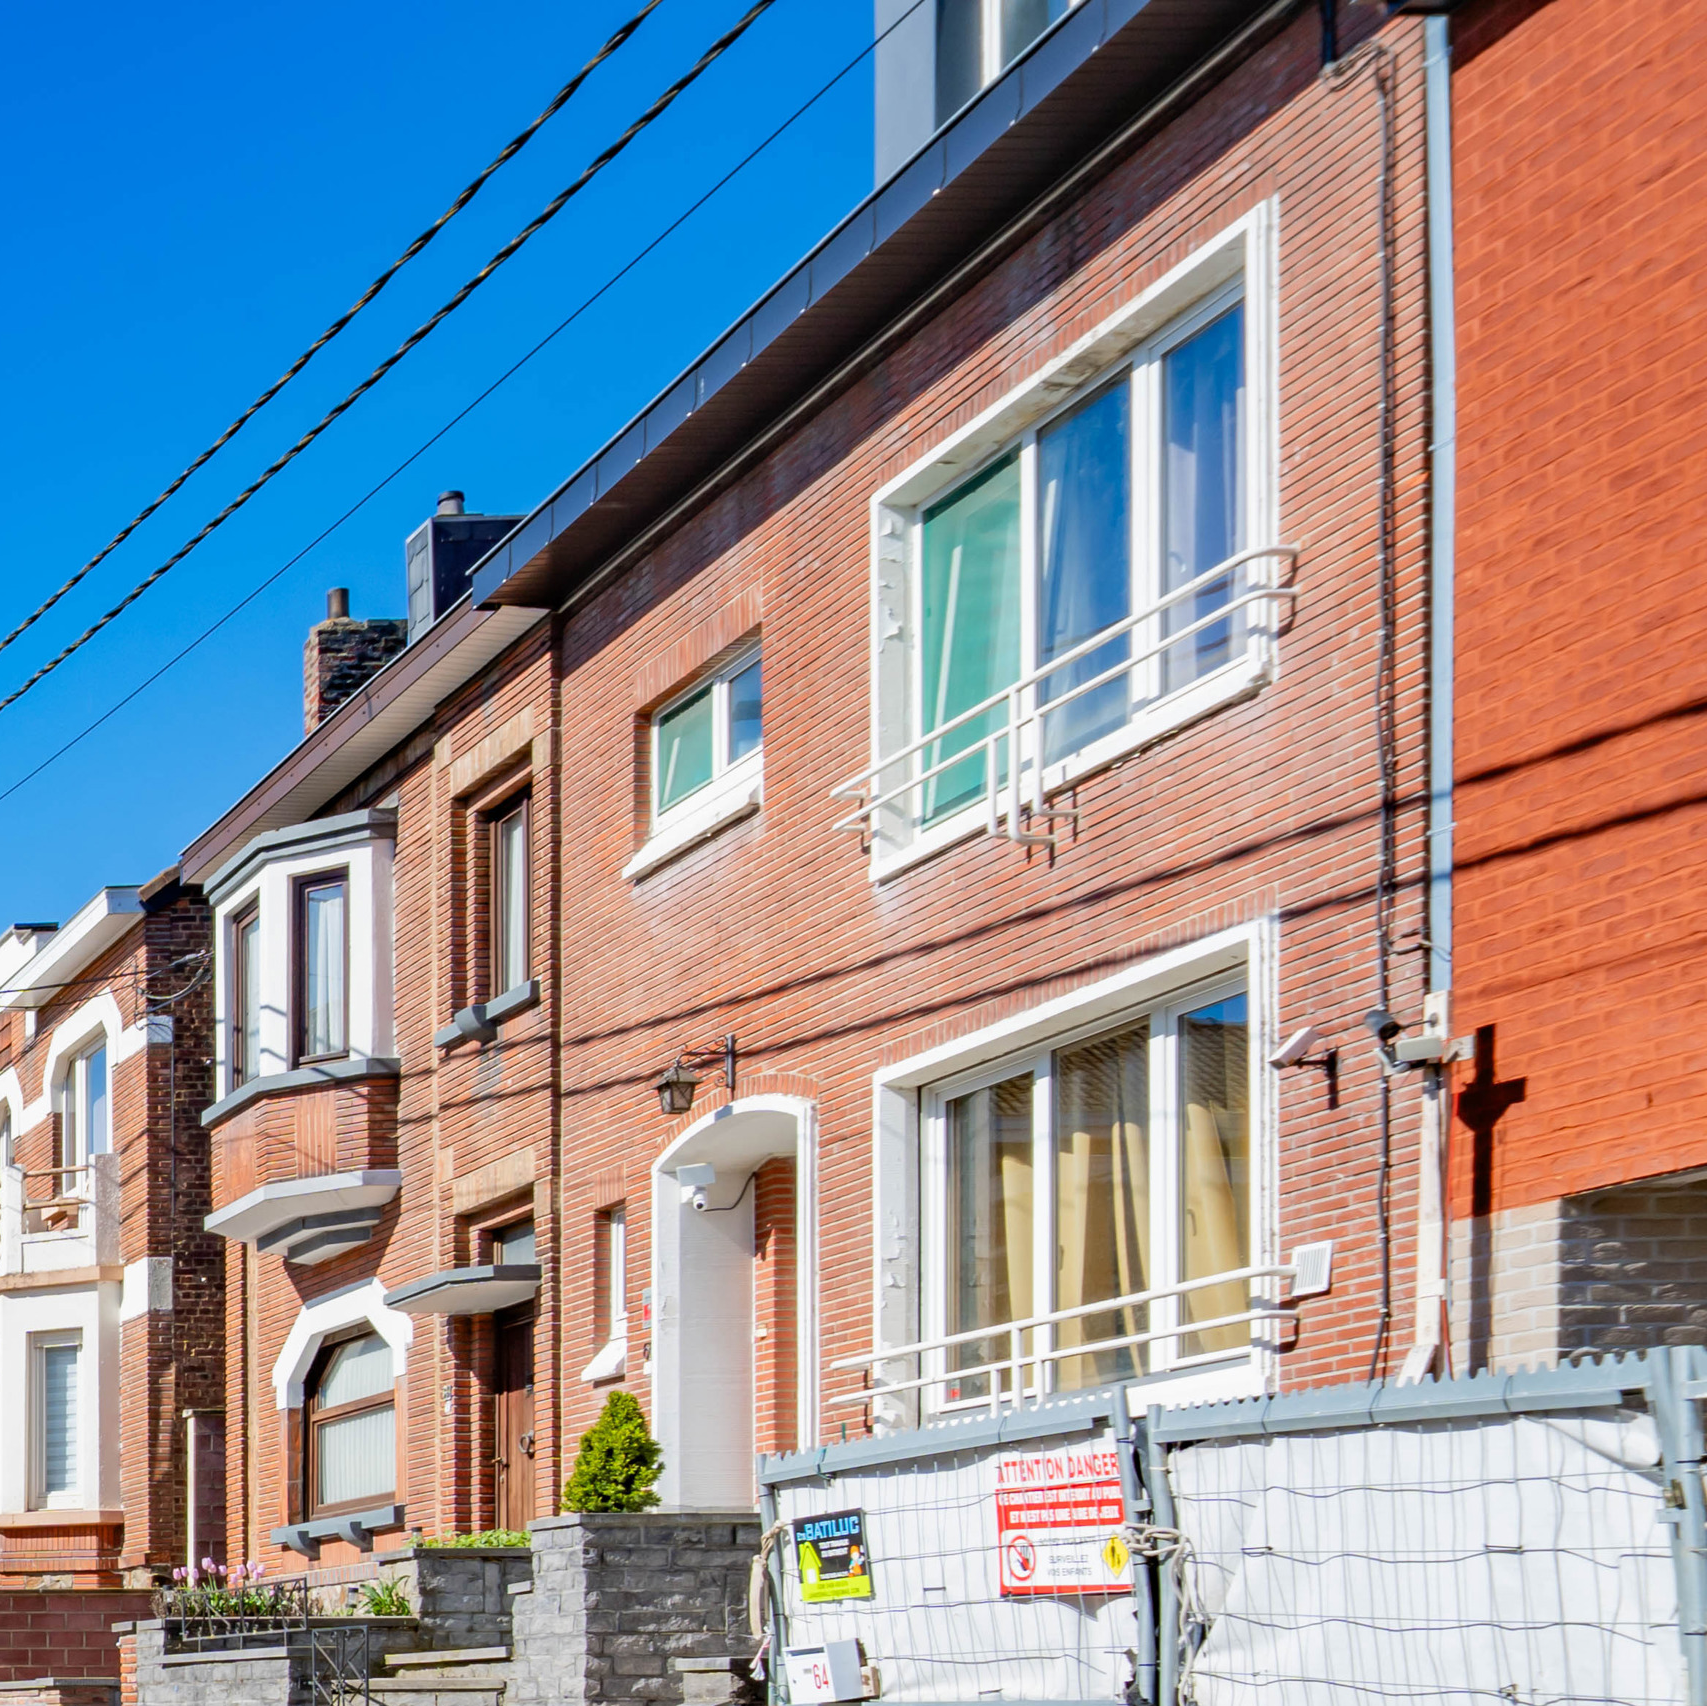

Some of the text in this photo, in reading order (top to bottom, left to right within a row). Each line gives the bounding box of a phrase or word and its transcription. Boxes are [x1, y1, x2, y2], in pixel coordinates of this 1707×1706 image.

[997, 1453, 1121, 1483] ATTENTION DANGER
[804, 1516, 860, 1541] BATILUC
[812, 1663, 829, 1690] 64
